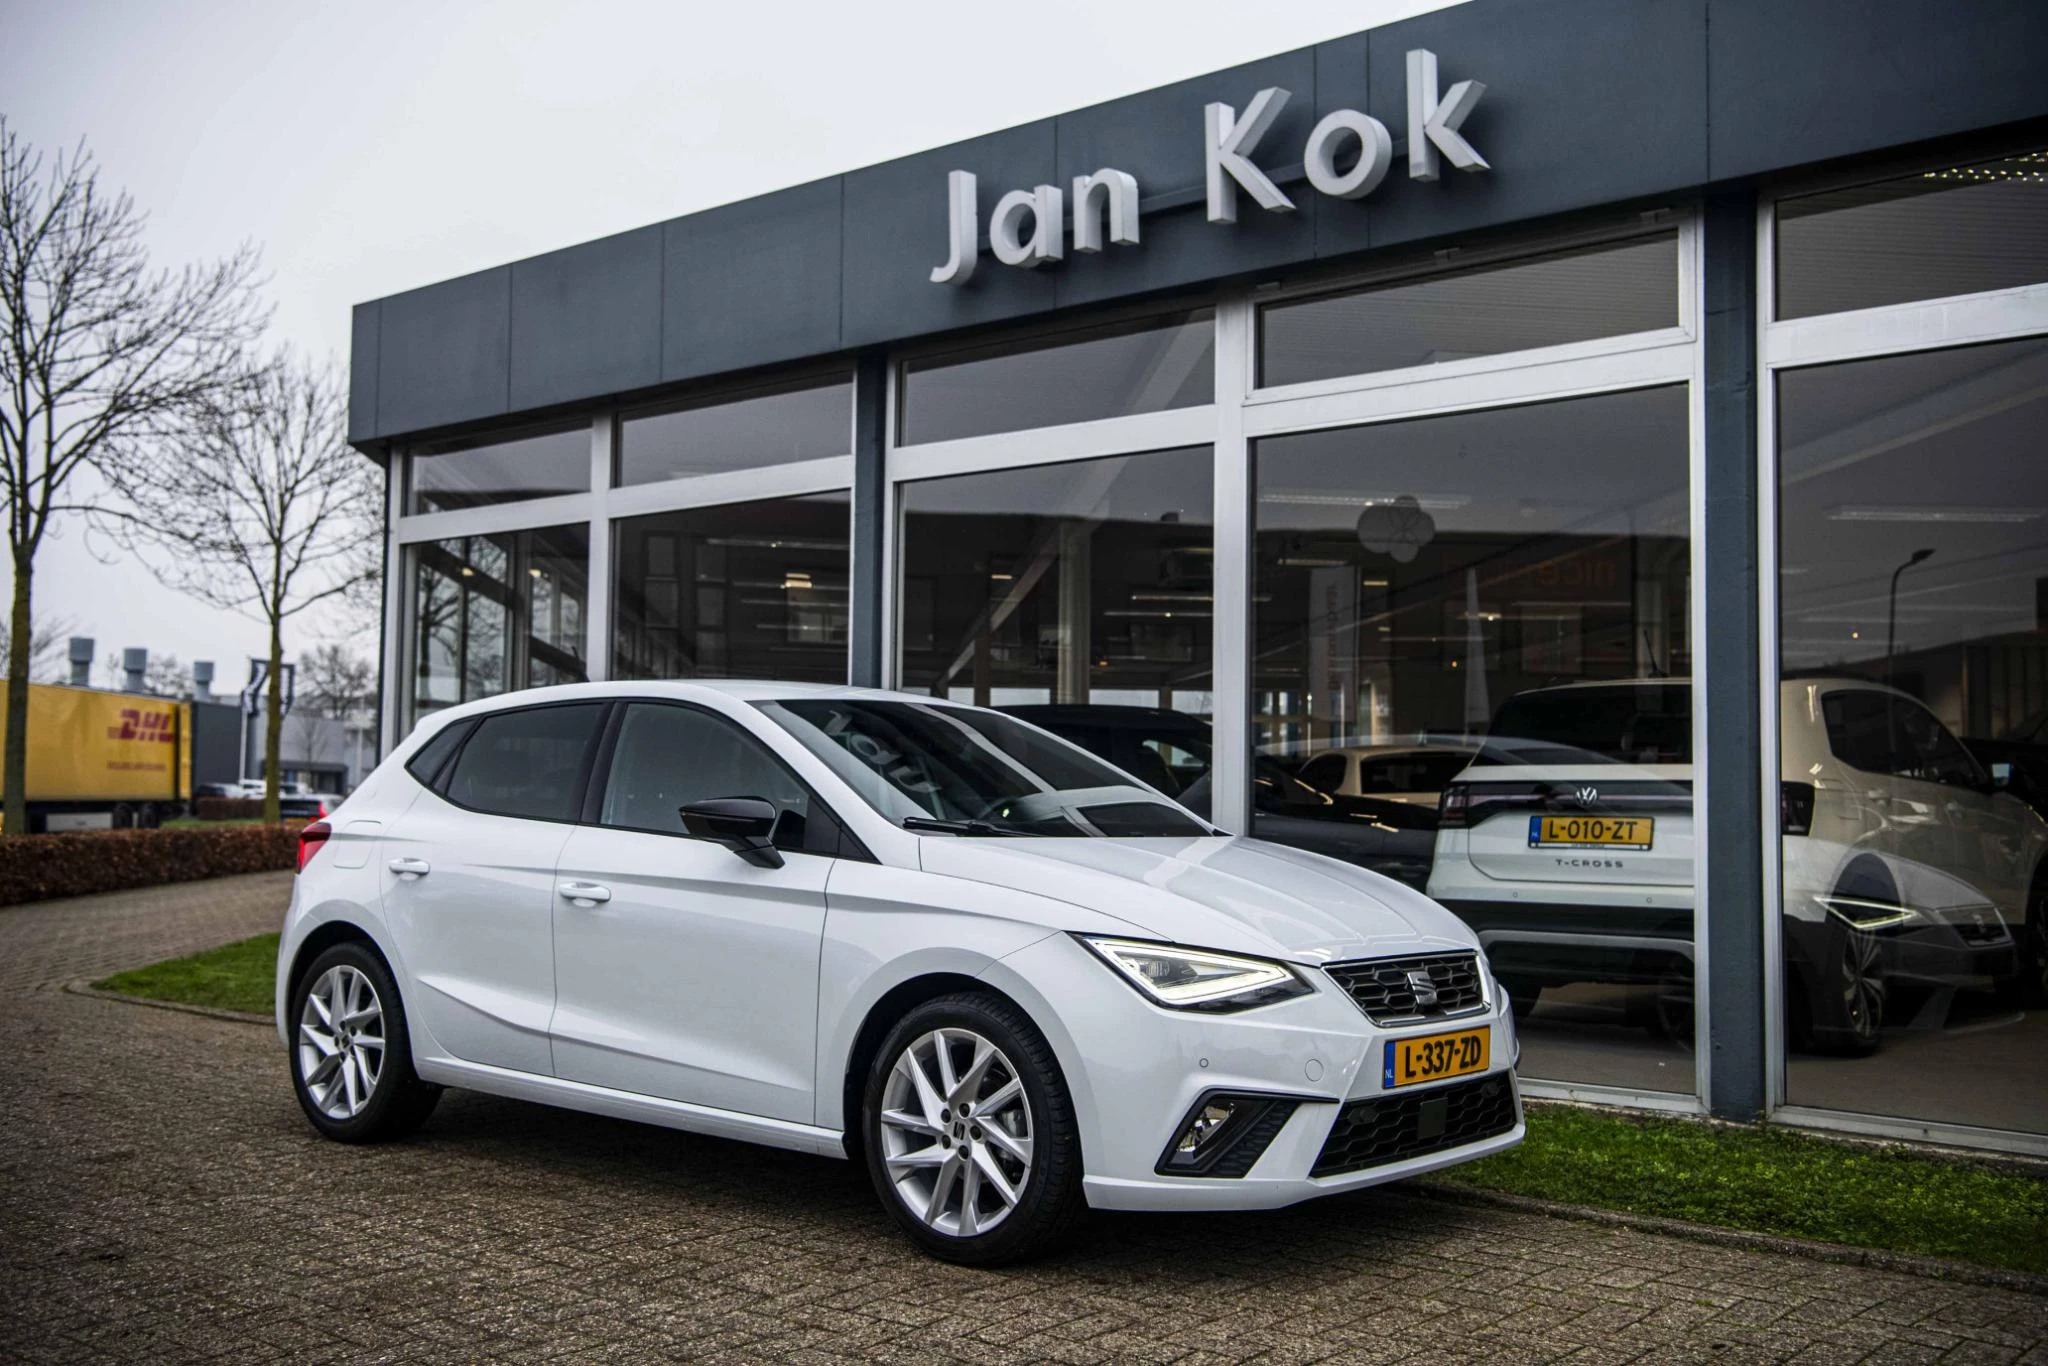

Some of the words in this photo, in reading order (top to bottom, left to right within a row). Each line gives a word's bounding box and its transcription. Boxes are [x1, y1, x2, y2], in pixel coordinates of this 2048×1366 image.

[930, 167, 1140, 284] Jan
[1204, 48, 1491, 224] Kok
[120, 708, 175, 742] DHL
[1548, 820, 1638, 840] L-010-ZT
[1556, 859, 1624, 868] T-CROSS
[1405, 1036, 1482, 1079] L-337-ZD
[1385, 1069, 1394, 1079] NL
